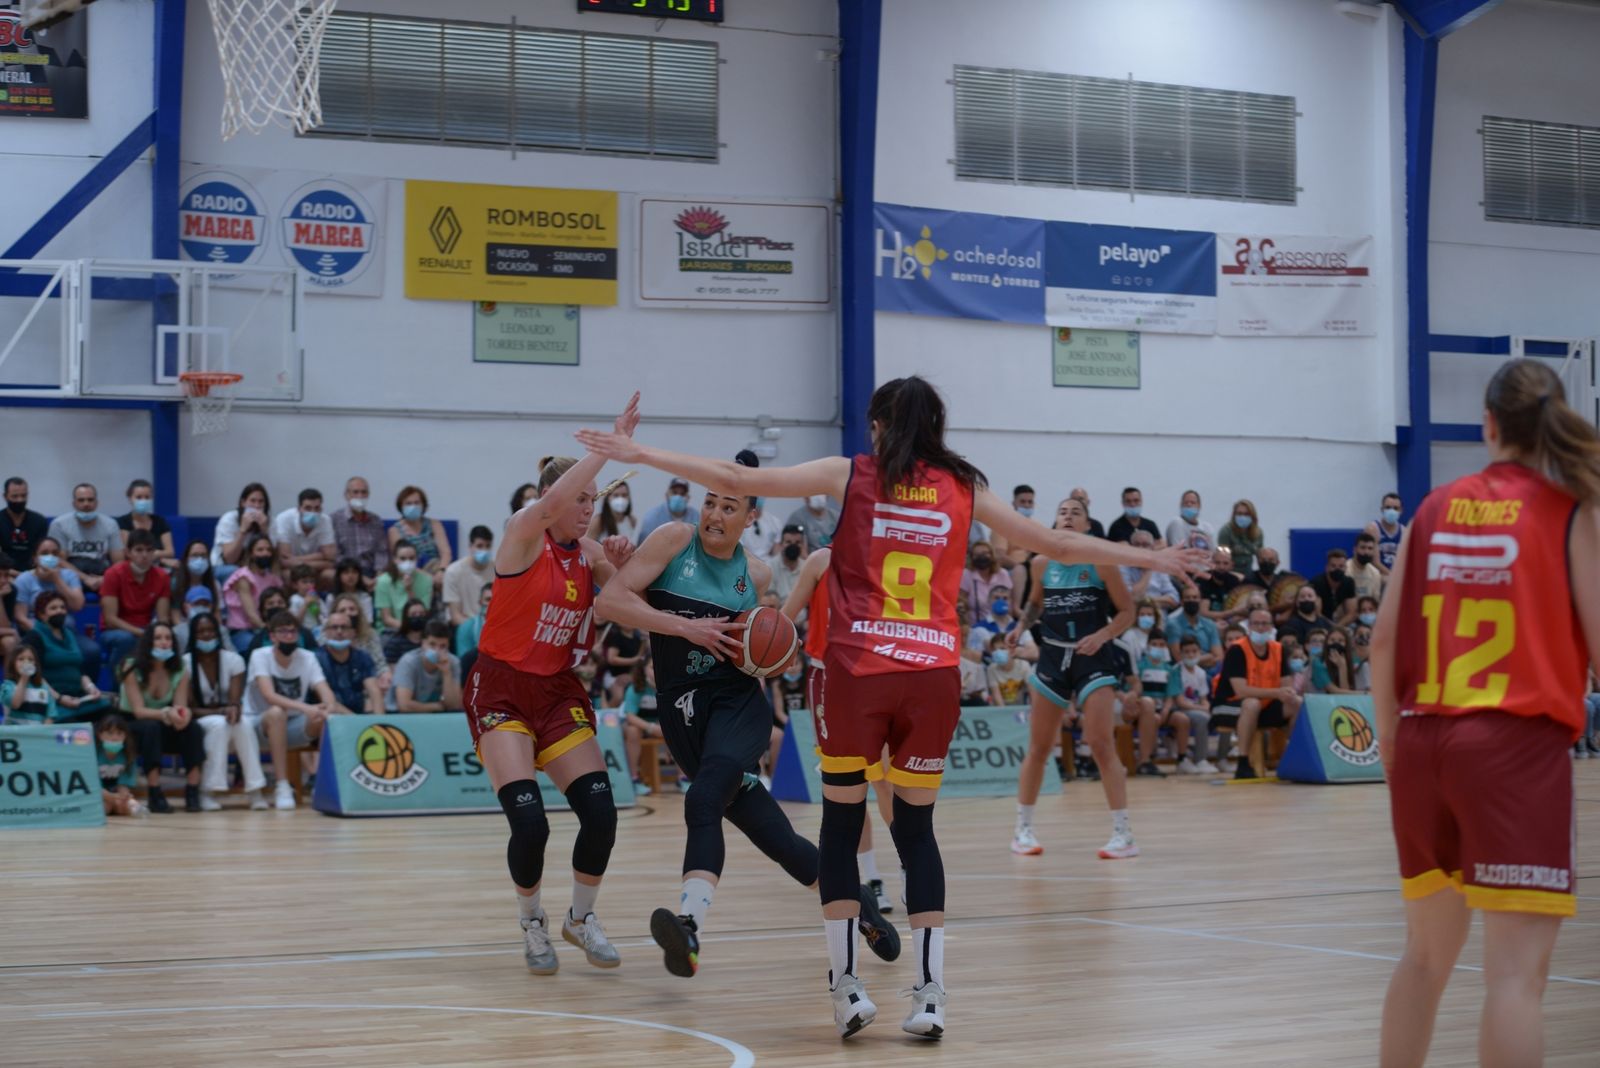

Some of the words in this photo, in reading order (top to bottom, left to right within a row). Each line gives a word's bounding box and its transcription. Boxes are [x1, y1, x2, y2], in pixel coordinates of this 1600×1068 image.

[191, 194, 248, 213] RADIO
[301, 202, 356, 220] RADIO
[184, 214, 256, 241] MARCA
[487, 208, 606, 230] ROMBOSOL
[293, 222, 364, 248] MARCA
[418, 257, 473, 270] RENAULT
[496, 249, 530, 259] NUEVO
[553, 251, 607, 262] SEMINUEVO
[953, 245, 1041, 270] achedosol
[1099, 242, 1161, 269] pelayo
[680, 260, 733, 271] JARDINES
[745, 262, 792, 273] PISCINAS
[951, 272, 990, 284] MONTES
[1002, 277, 1041, 289] TORRES
[513, 306, 542, 319] PISTA
[500, 322, 555, 336] LEONARDO
[487, 338, 524, 351] TORRES
[1085, 335, 1109, 347] PISTA
[1089, 351, 1127, 362] ANTONIO
[894, 483, 938, 504] CLARA
[882, 551, 933, 621] 9
[851, 620, 956, 652] ALCOBENDAS
[894, 649, 938, 665] GEFF
[1416, 595, 1515, 708] 12
[354, 768, 427, 794] ESTEPONA
